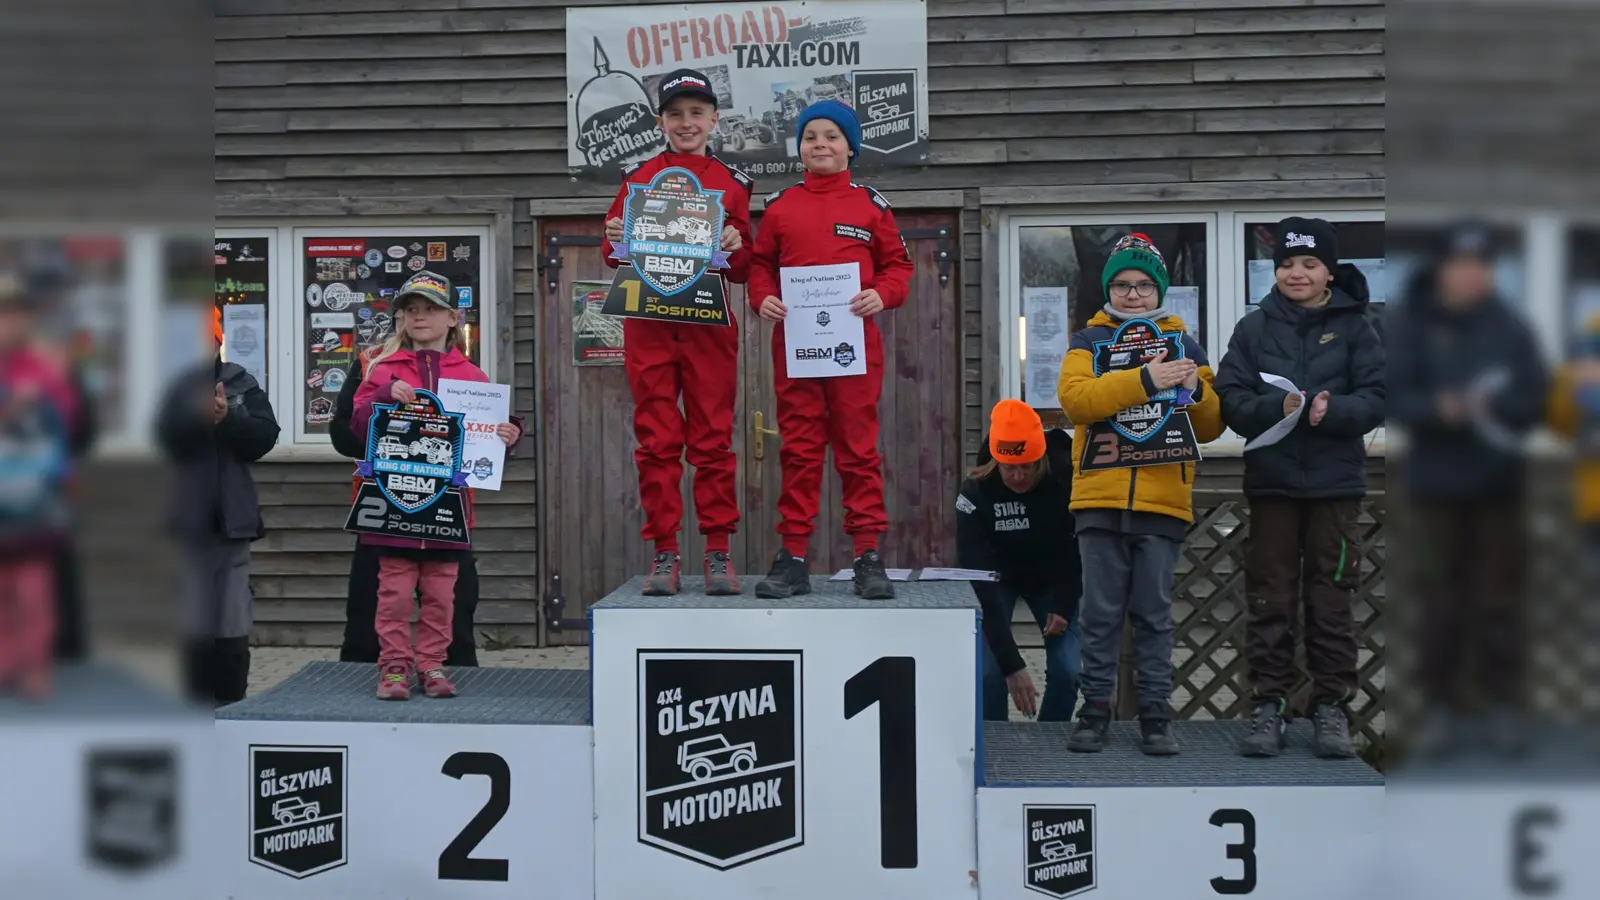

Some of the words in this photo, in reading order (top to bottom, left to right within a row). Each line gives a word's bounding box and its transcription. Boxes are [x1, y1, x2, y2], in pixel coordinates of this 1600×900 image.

[663, 76, 706, 91] POLARIS
[859, 82, 907, 104] OLSZYNA
[862, 117, 910, 141] MOTOPARK
[766, 163, 785, 174] 600
[796, 162, 805, 173] 8
[633, 242, 656, 253] KING
[657, 244, 669, 253] OF
[671, 245, 711, 257] NATIONS
[644, 255, 695, 272] BSM
[660, 275, 677, 283] 2025
[618, 279, 641, 312] 1
[694, 297, 714, 305] Class
[645, 304, 723, 320] POSITION
[796, 347, 832, 359] BSM
[447, 388, 461, 396] King
[464, 422, 496, 433] XXIS
[1131, 422, 1148, 430] 2025
[1092, 432, 1119, 465] 3
[1120, 447, 1193, 463] POSITION
[376, 461, 399, 471] KING
[400, 462, 411, 472] OF
[413, 464, 452, 477] NATIONS
[388, 474, 436, 491] BSM
[402, 493, 419, 502] 2025
[357, 496, 388, 529] 2
[388, 512, 402, 521] ND
[993, 501, 1027, 517] STAFF
[435, 515, 454, 523] Class
[995, 518, 1030, 530] BSM
[388, 521, 462, 537] POSITION
[656, 687, 682, 705] 4X4
[658, 684, 777, 736] OLSZYNA
[843, 655, 918, 869] 1
[260, 767, 276, 779] 4X4
[260, 766, 332, 798] OLSZYNA
[662, 777, 782, 830] MOTOPARK
[437, 751, 511, 881] 2
[1032, 818, 1085, 842] OLSZYNA
[263, 822, 335, 855] MOTOPARK
[1208, 808, 1257, 895] 3
[1034, 858, 1088, 882] MOTOPARK
